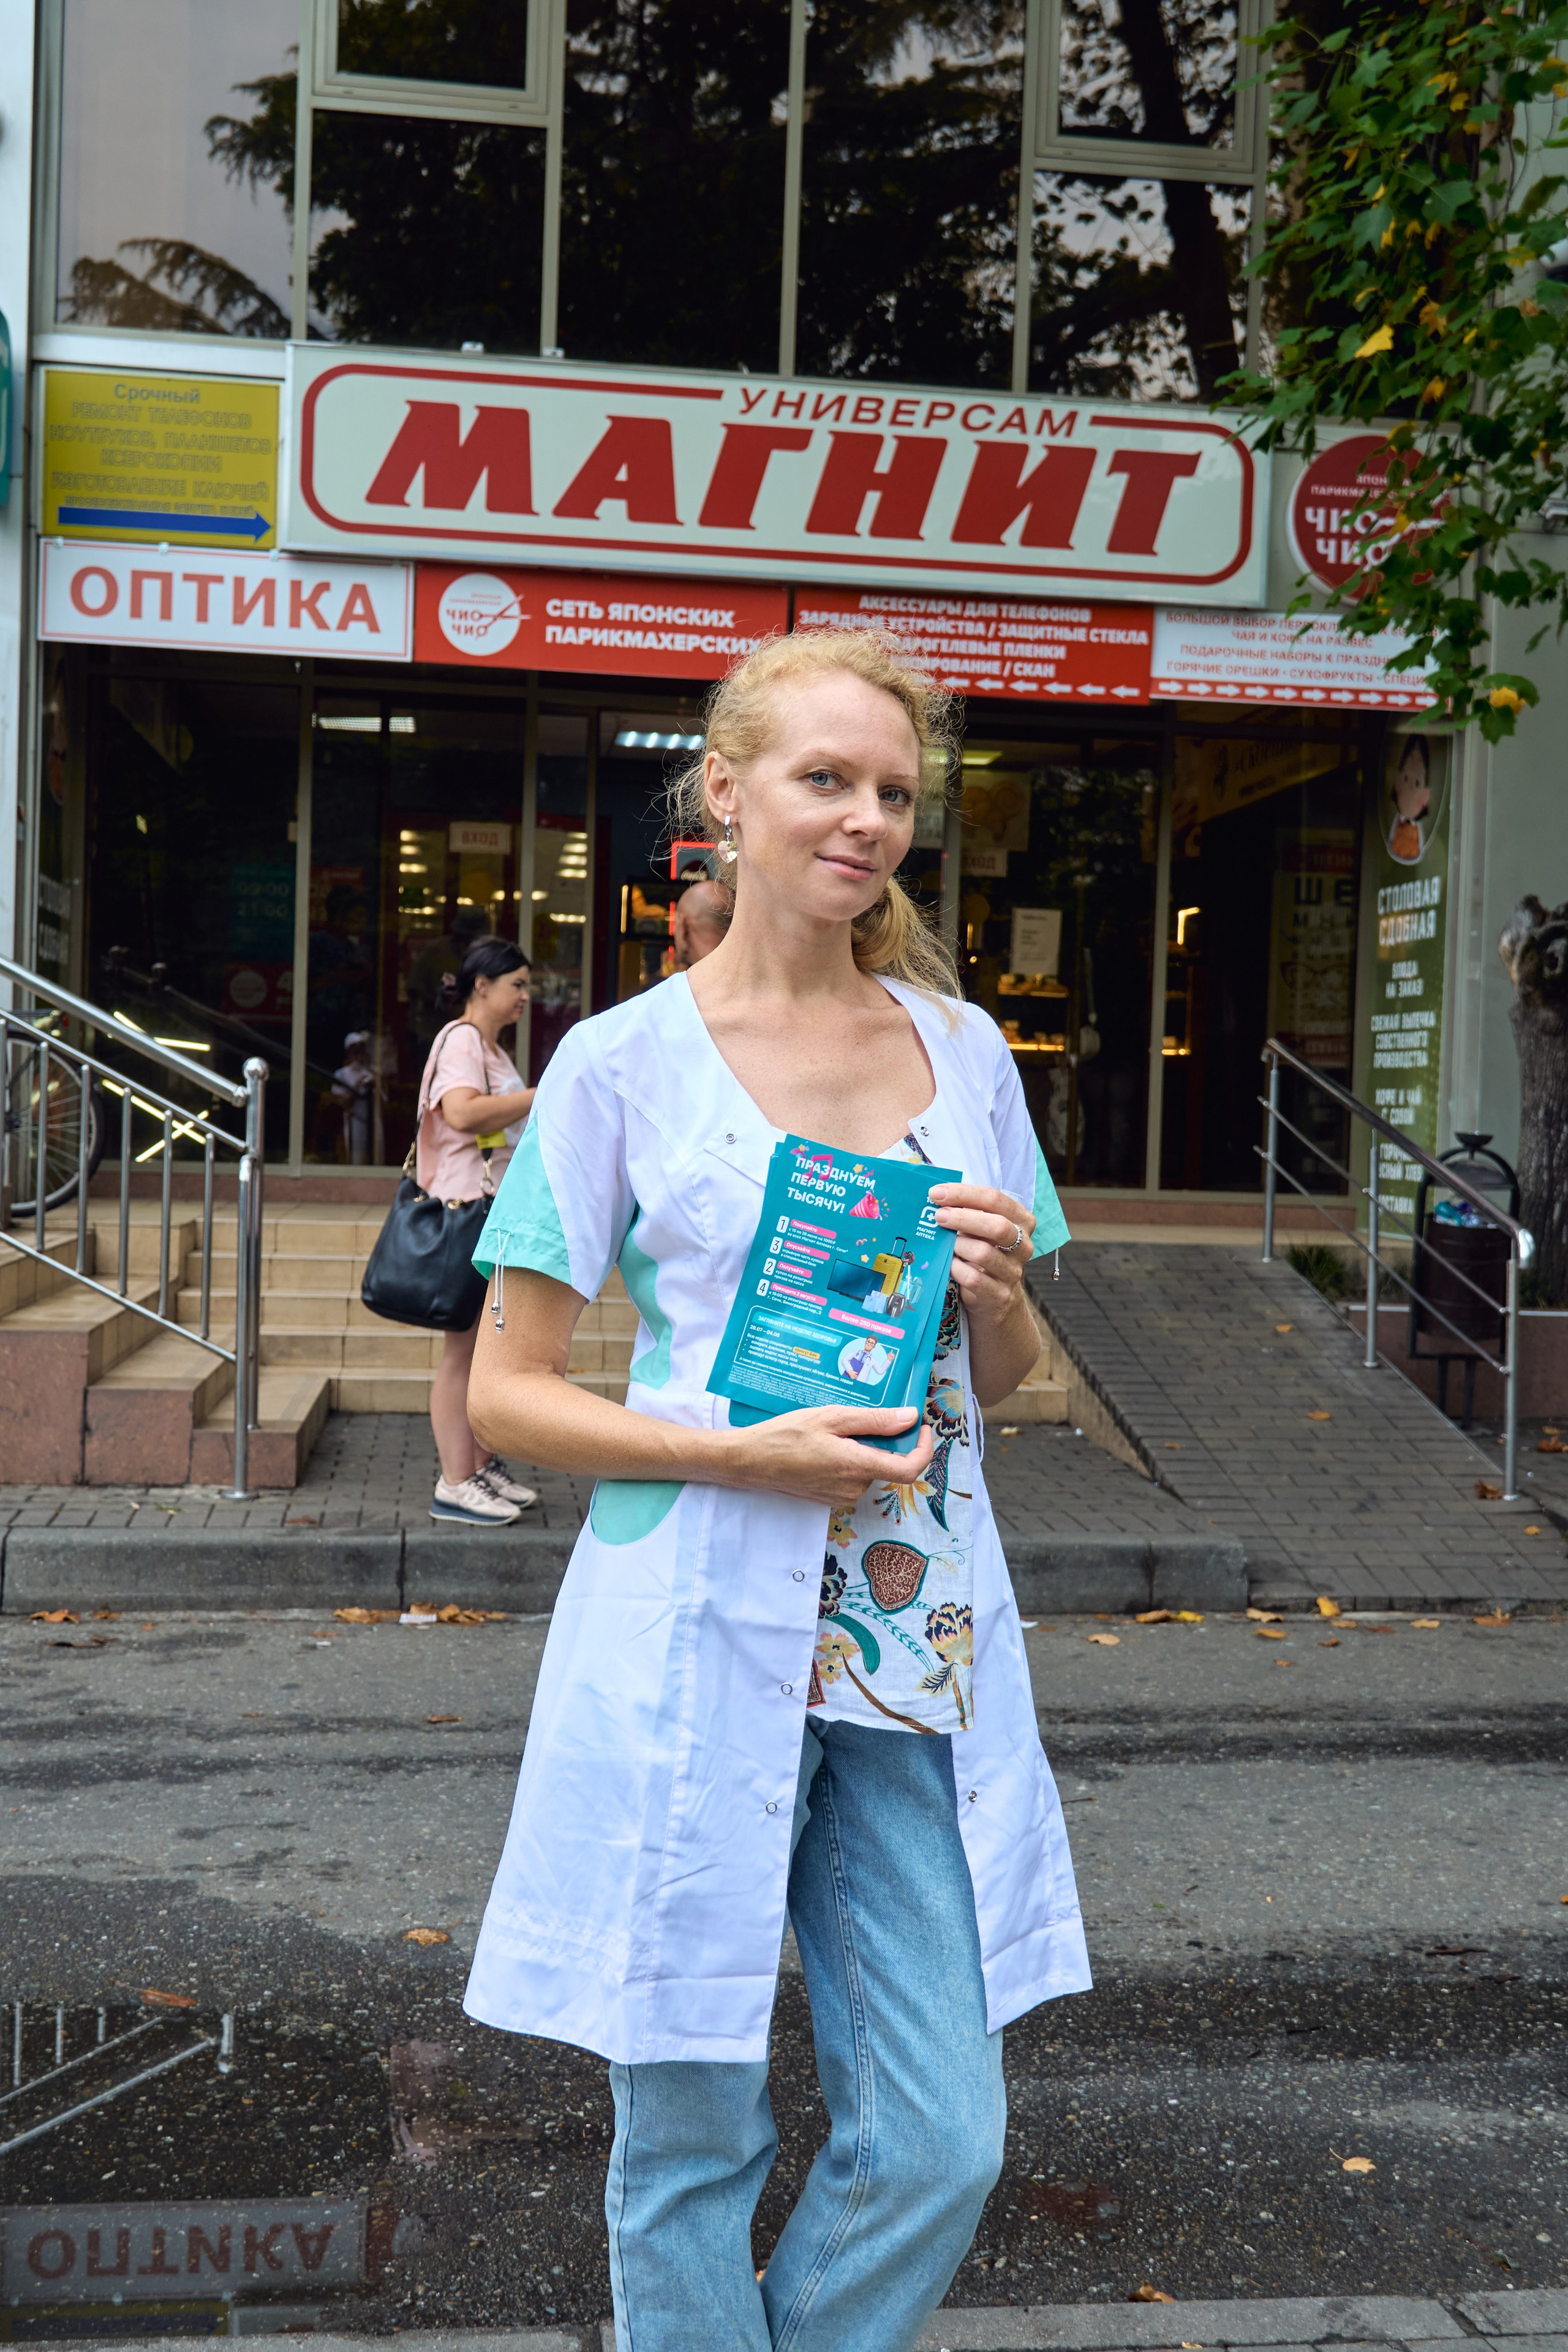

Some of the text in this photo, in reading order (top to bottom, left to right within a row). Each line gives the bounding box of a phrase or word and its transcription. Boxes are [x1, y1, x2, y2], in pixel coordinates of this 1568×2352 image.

[114, 383, 200, 403] Срочный
[71, 402, 252, 428] РЕМОНТ ТЕЛЕФОНОВ
[739, 388, 1078, 438] УНИВЕРСАМ
[50, 424, 271, 454] НОУТБУКОВ, ПЛАНШЕТОВ
[100, 448, 221, 472] КСЕРОКОПИИ
[51, 471, 269, 502] ИЗГОТОВЛЕНИЕ КЛЮЧЕЙ
[365, 399, 1202, 556] МАГНИТ
[70, 565, 381, 635] ОПТИКА
[859, 595, 1092, 623] АКСЕССУАРЫ ДЛЯ ТЕЛЕФОНОВ
[546, 598, 735, 628] СЕТЬ ЯПОНСКИХ
[1166, 612, 1230, 625] БОЛЬШОЙ
[1232, 617, 1276, 628] ВЫБОР
[546, 625, 762, 655] ПАРИКМАХЕРСКИХ
[887, 616, 987, 636] УСТРОЙСТВА
[998, 622, 1088, 642] ЗАЩИТНЫЕ
[1089, 628, 1149, 645] СТЕКЛА
[1232, 630, 1373, 647] ЧАЯ И КОФЕ НА РАЗВЕС
[1003, 643, 1066, 660] ПЛЕНКИ
[1180, 644, 1392, 668] ПОДАРОЧНЫЕ НАБОРЫ К ПРАЗДН
[1013, 662, 1055, 678] СКАН
[1167, 661, 1426, 687] ГОРЯЧИЕ ОРЕШКИ СУХОФРУКТЫ СПЕЦИ
[1378, 875, 1441, 916] СТОЛОВАЯ
[1379, 908, 1437, 947] СДОБНАЯ
[1392, 960, 1419, 979] БЛЮДА
[1385, 978, 1424, 999] НА ЗАКАЗ
[1371, 1010, 1436, 1032] СВЕЖАЯ ВЫПЕЧКА
[1376, 1030, 1429, 1050] СОБСТВЕННОГО
[1373, 1050, 1428, 1069] ПРОИЗВОДСТВА
[1375, 1085, 1422, 1107] КОФЕ И ЧАЙ
[1390, 1106, 1415, 1125] СОБОЙ
[794, 1156, 876, 1190] ПРАЗДНУЕМ
[1404, 1164, 1424, 1182] ХЛЕБ
[790, 1171, 847, 1197] ПЕРВУЮ
[785, 1186, 846, 1214] ТЫСЯЧУ!
[778, 1218, 785, 1231] 1
[792, 1221, 818, 1233] Покупайте
[916, 1226, 937, 1235] МАГНИТ
[772, 1239, 780, 1251] 3
[815, 1240, 832, 1249] Аптеках
[914, 1231, 935, 1240] АПТЕКА
[781, 1248, 801, 1257] отрывную
[785, 1242, 811, 1254] Опускайте
[765, 1261, 774, 1273] 2
[783, 1254, 808, 1264] специальный
[778, 1263, 804, 1275] Получайте
[758, 1281, 767, 1294] 4
[792, 1275, 813, 1284] розыгрыш
[772, 1284, 796, 1295] Приходите
[799, 1292, 816, 1302] августа
[787, 1296, 808, 1306] розыгрыш
[782, 1299, 809, 1311] Виноградный
[757, 1314, 785, 1328] ЗАГЛЯНИТЕ
[791, 1325, 812, 1336] НЕДЕЛЮ
[811, 1331, 837, 1344] ЗДОРОВЬЯ
[840, 1313, 892, 1335] Более 250 призов
[768, 1340, 793, 1350] специалисты
